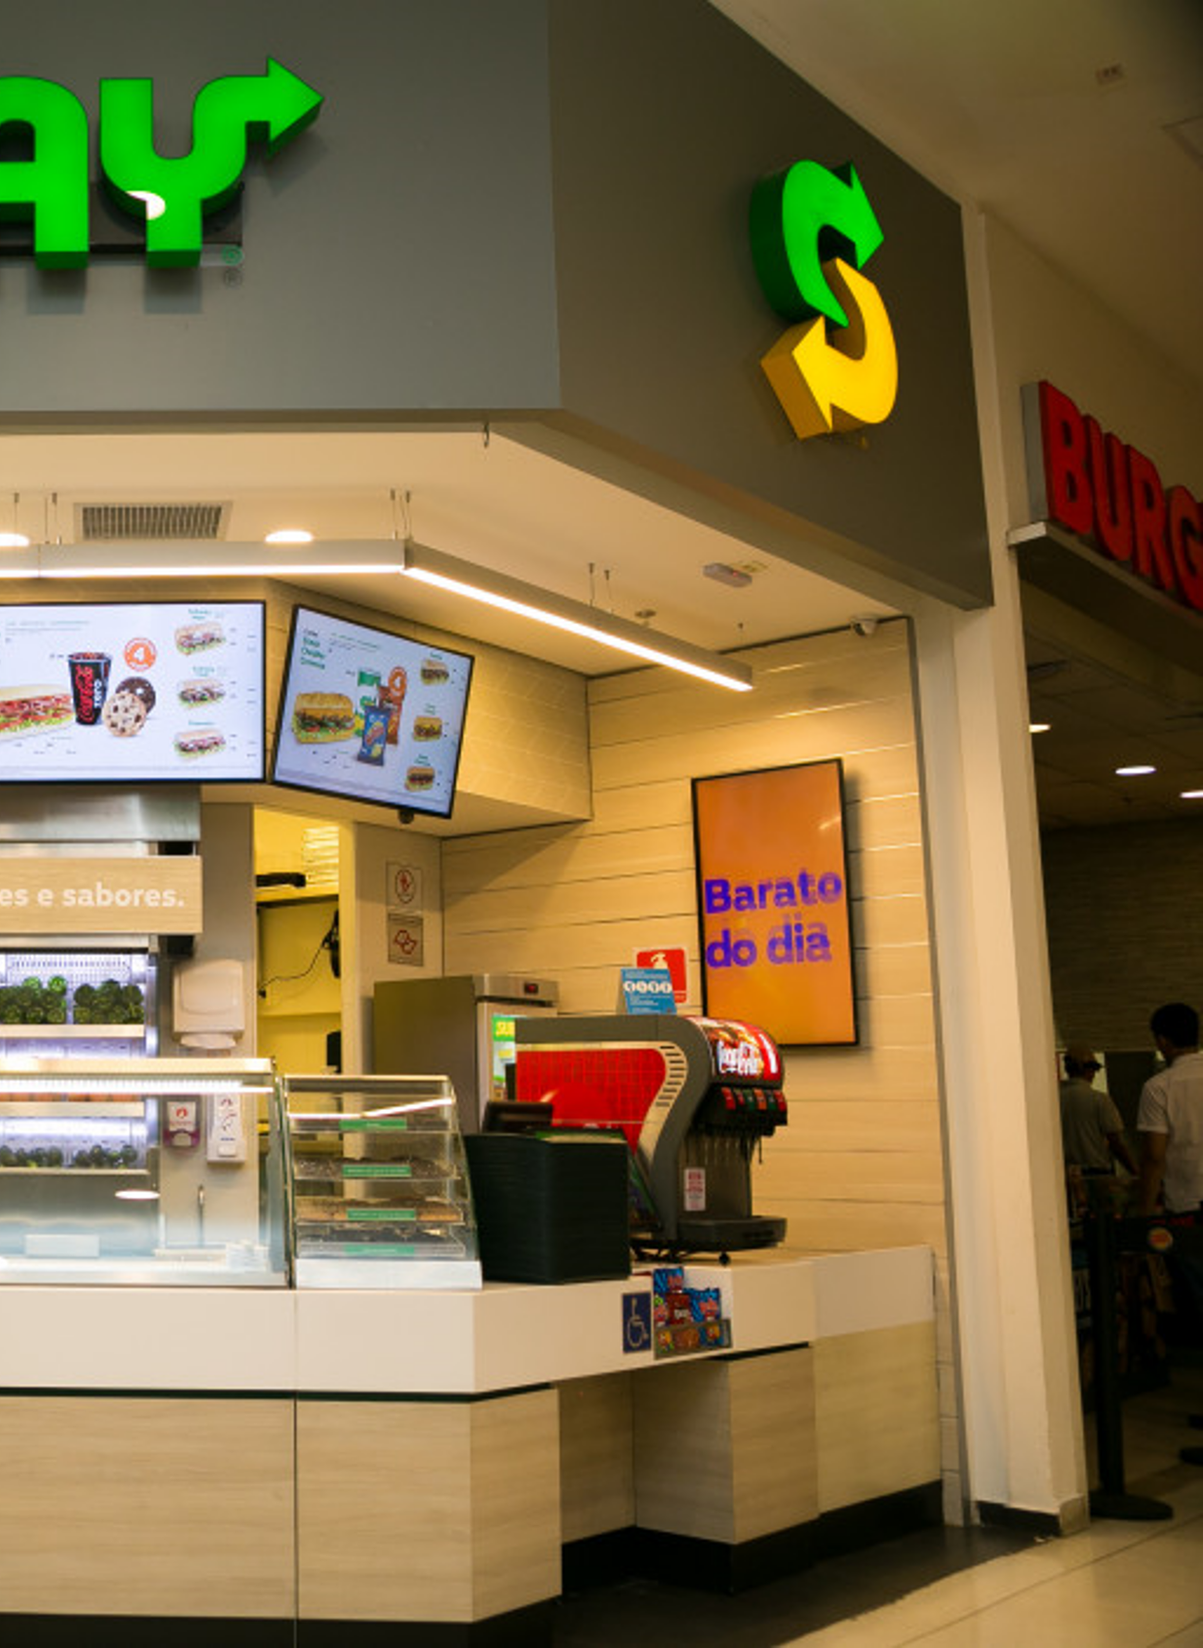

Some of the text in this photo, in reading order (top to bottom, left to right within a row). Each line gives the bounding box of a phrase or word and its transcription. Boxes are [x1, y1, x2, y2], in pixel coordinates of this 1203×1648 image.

[37, 889, 54, 908] e
[62, 881, 186, 908] sabores.
[703, 867, 843, 914] Barato
[705, 915, 833, 969] do dia
